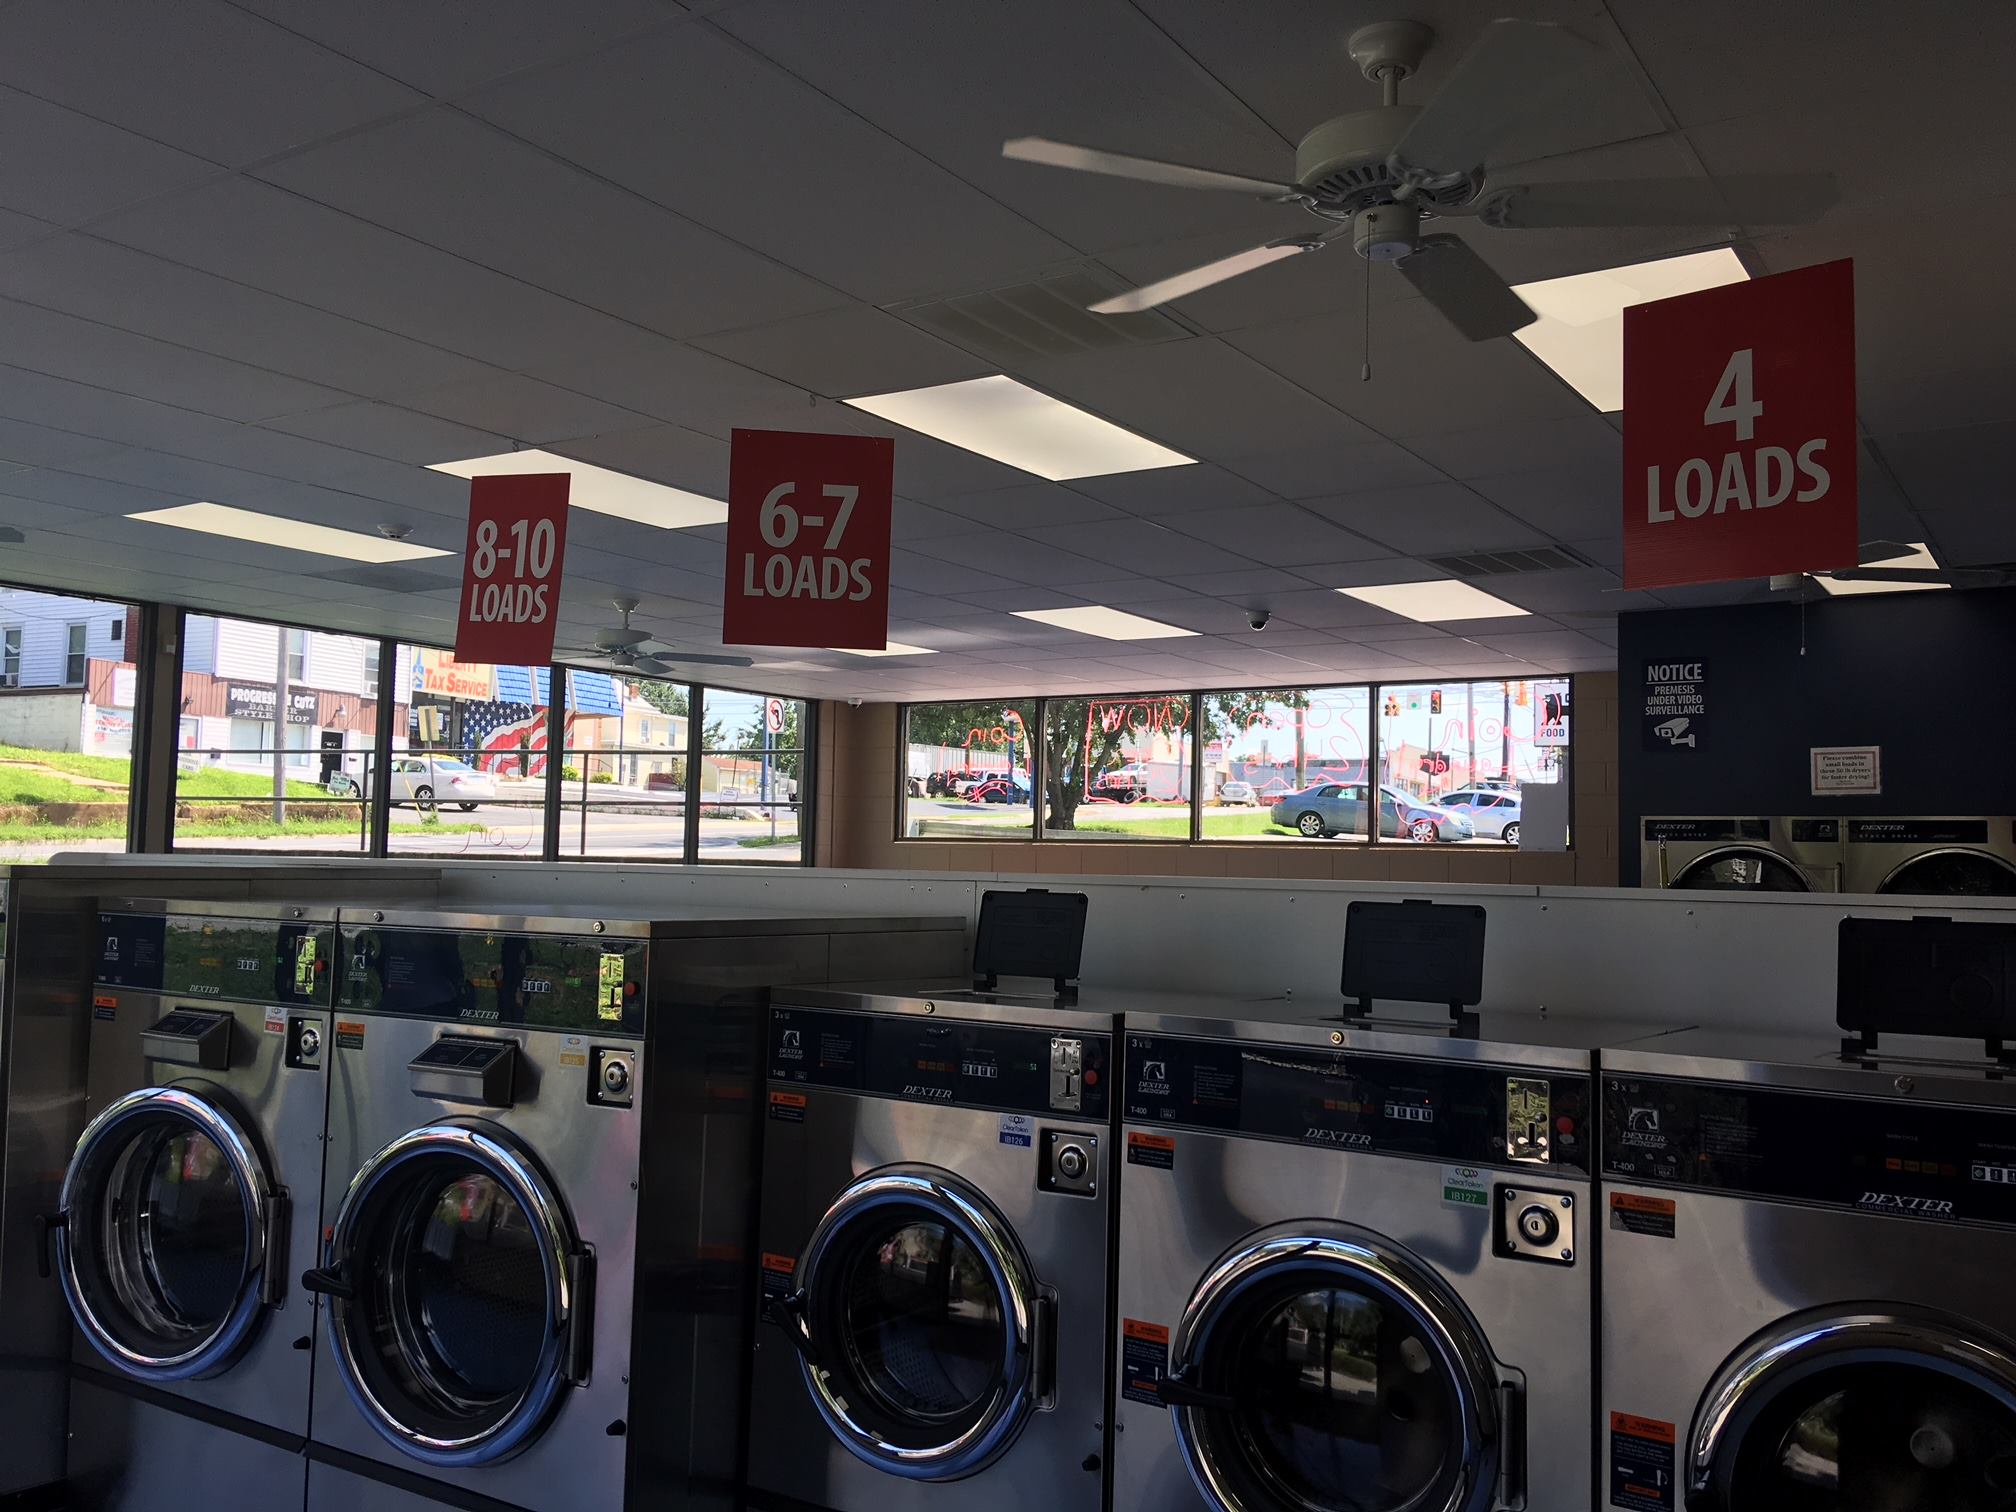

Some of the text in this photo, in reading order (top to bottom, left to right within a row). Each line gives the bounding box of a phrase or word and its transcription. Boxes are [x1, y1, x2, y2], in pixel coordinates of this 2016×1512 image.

[1704, 348, 1763, 441] 4
[1647, 438, 1831, 524] LOADS
[759, 481, 860, 550] 6-7
[472, 518, 556, 579] 8-10
[743, 553, 872, 601] LOADS
[469, 583, 548, 624] LOADS
[1648, 663, 1702, 681] NOTICE
[425, 668, 488, 697] TAX SERVICE
[1654, 685, 1695, 695] PREMESIS
[294, 695, 316, 709] CUTZ
[1647, 695, 1702, 705] UNDER VIDEO
[234, 708, 273, 719] STYLE
[1645, 705, 1705, 715] SURVEILLANCE
[1541, 728, 1565, 737] FOOD
[189, 984, 220, 994] DEXTER
[460, 1008, 500, 1020] DEXTER
[1132, 1038, 1137, 1048] 3
[1138, 1080, 1170, 1090] DEXTER
[1611, 1081, 1619, 1091] 3
[903, 1085, 953, 1099] DEXTER
[1130, 1105, 1148, 1114] T-400
[1304, 1127, 1372, 1145] DEXTER
[1621, 1131, 1667, 1143] DEXTER
[1611, 1160, 1635, 1172] T-400
[1451, 1191, 1477, 1203] IB127
[1858, 1191, 1953, 1214] DEXTER
[1855, 1202, 1956, 1220] COMMERCIAL WASHER
